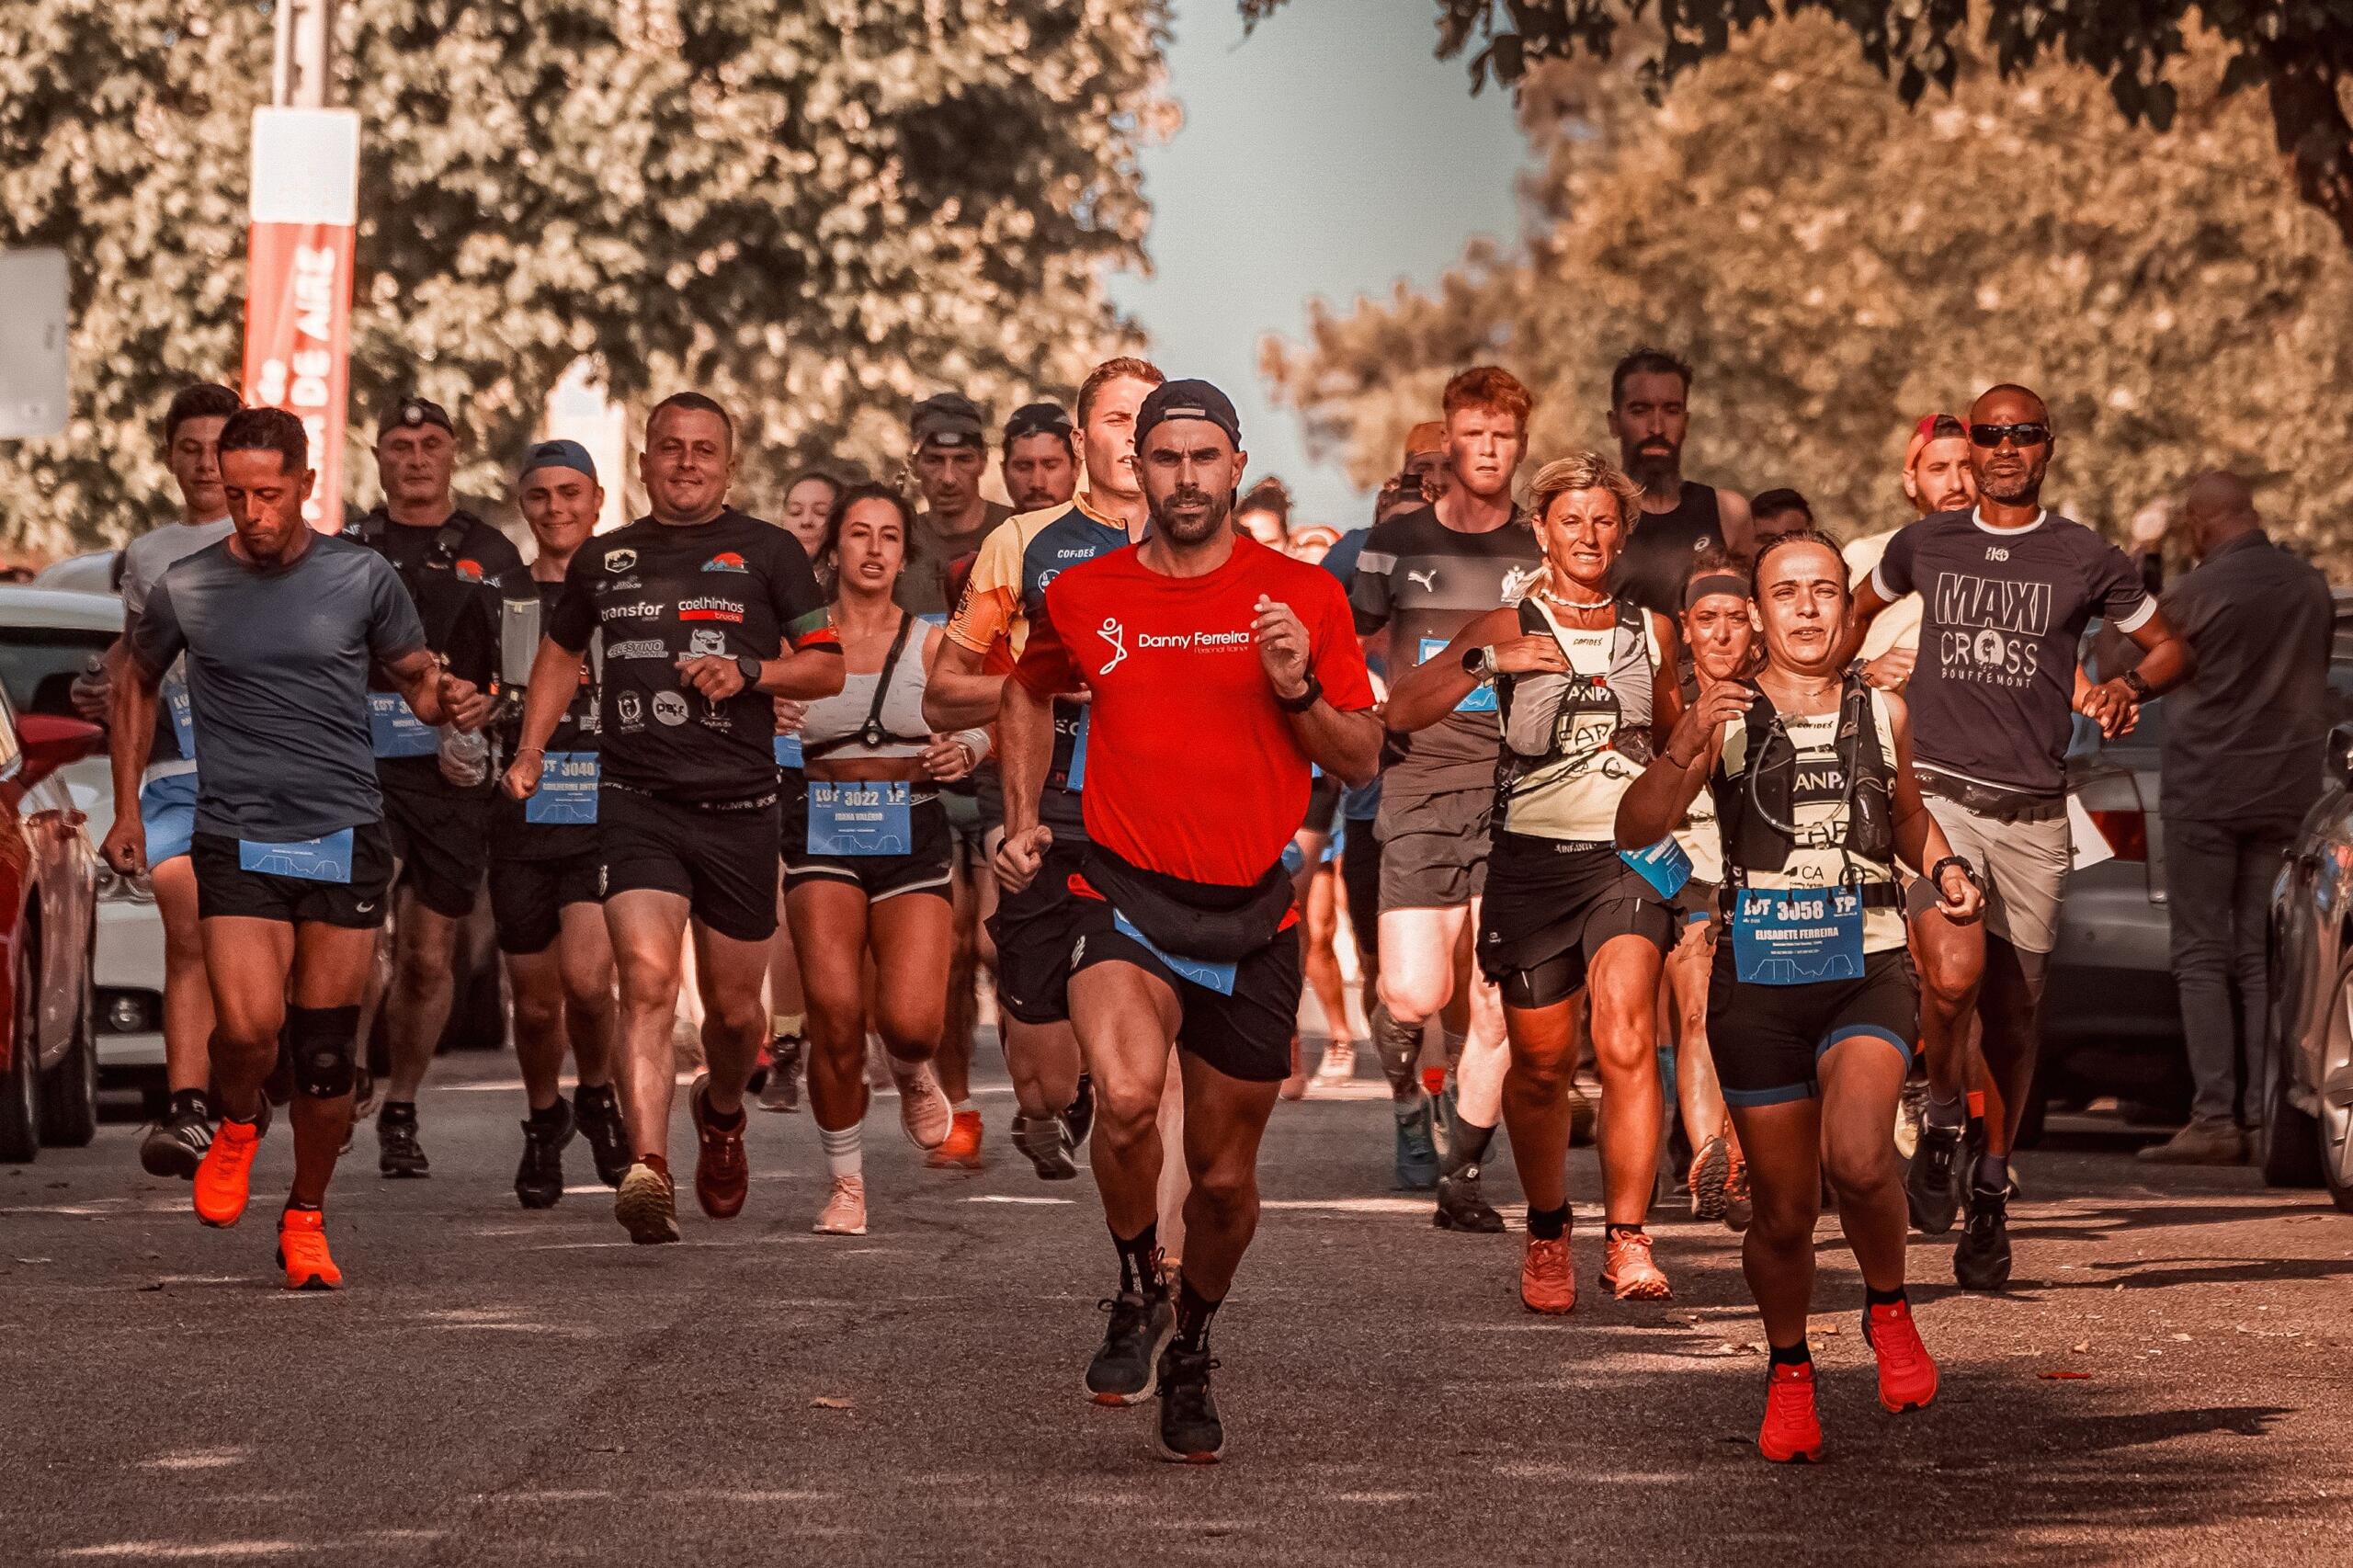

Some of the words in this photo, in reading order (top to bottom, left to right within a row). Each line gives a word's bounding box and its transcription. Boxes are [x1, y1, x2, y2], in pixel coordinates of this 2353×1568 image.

[601, 602, 665, 621] transfor
[677, 597, 745, 613] coelhinhos
[1936, 573, 2051, 636] MAXI
[1138, 633, 1191, 649] Danny
[1194, 631, 1250, 645] Ferreira
[608, 641, 664, 657] CELESTINO
[1941, 629, 2038, 677] CROSS
[562, 762, 596, 777] 3040
[845, 791, 880, 807] 3022
[1802, 866, 1824, 881] CA
[1777, 900, 1824, 921] 3058
[1799, 926, 1839, 938] FERREIRA
